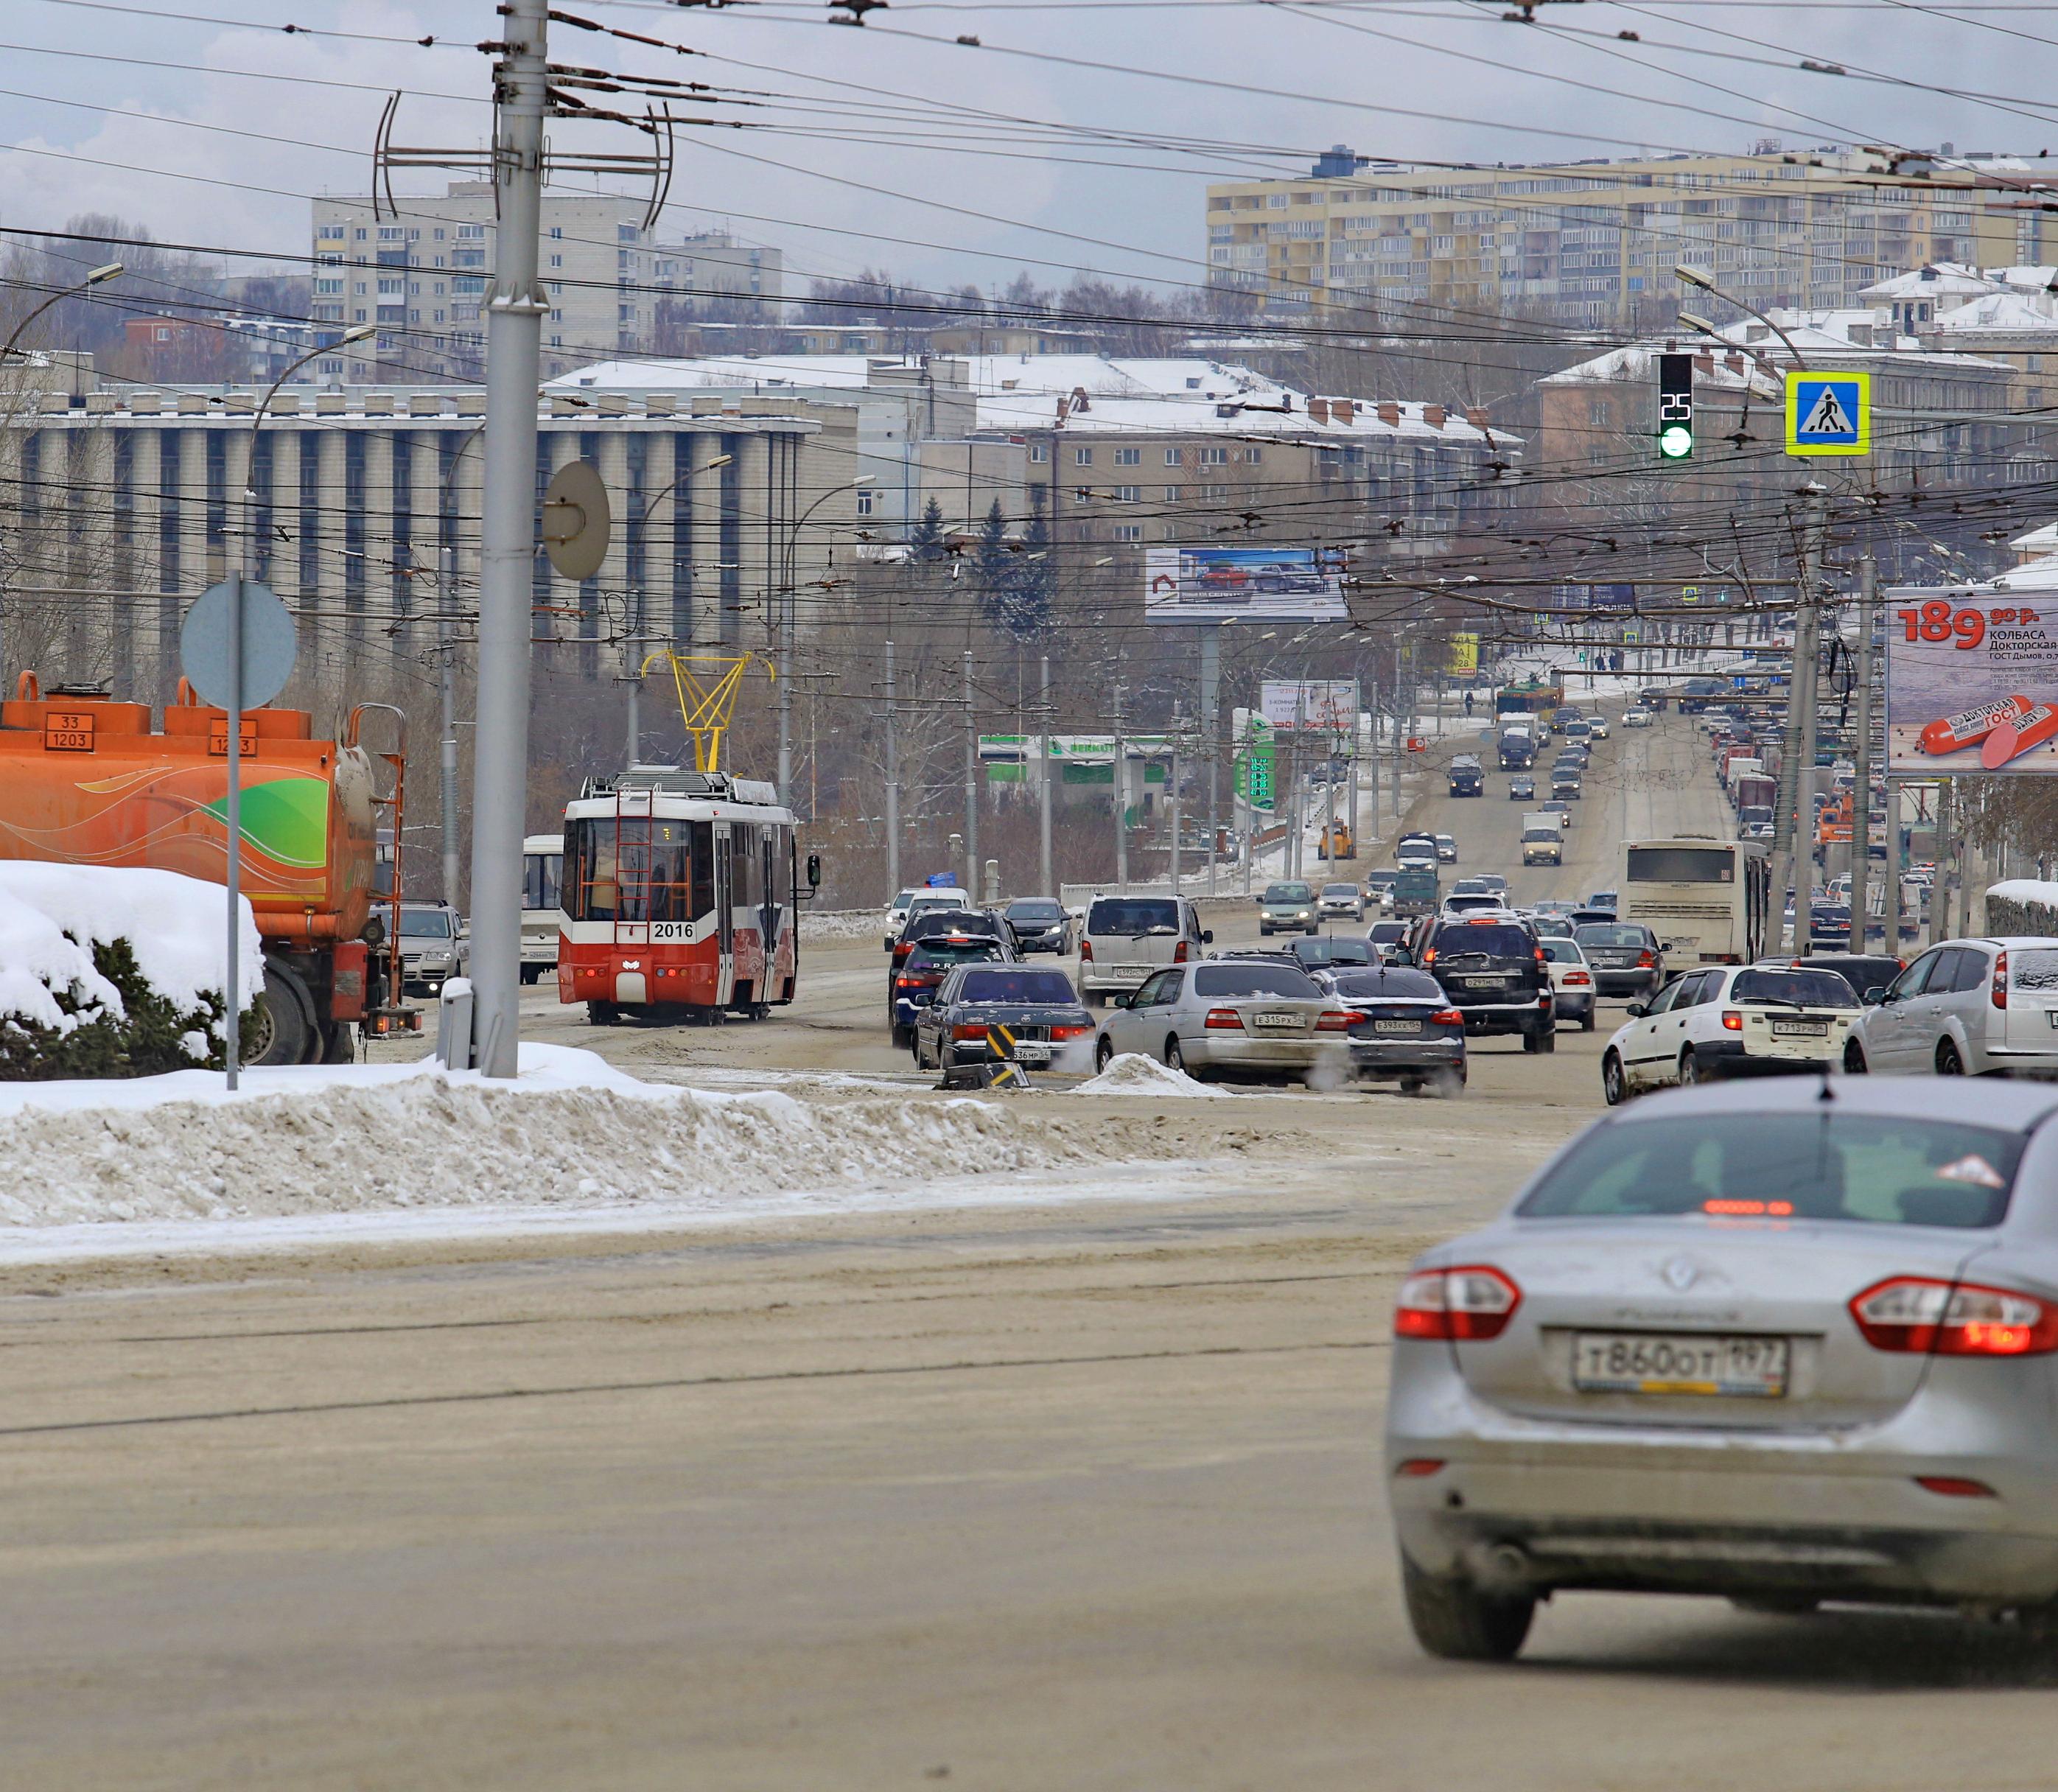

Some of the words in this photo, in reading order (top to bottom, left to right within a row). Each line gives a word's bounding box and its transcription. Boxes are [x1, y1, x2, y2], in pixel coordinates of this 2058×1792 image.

[1661, 393, 1690, 420] 25
[1990, 608, 2017, 626] 90
[1898, 600, 1985, 649] 189
[1990, 631, 2045, 640] КОЛБАСА
[1989, 641, 2057, 651] Докторская
[1963, 699, 2015, 722] ДОКТОРСКАЯ
[1985, 706, 2017, 727] ГОСТ
[62, 716, 78, 729] 33
[54, 733, 85, 746] 1203
[217, 739, 249, 752] 123
[654, 923, 693, 937] 2016
